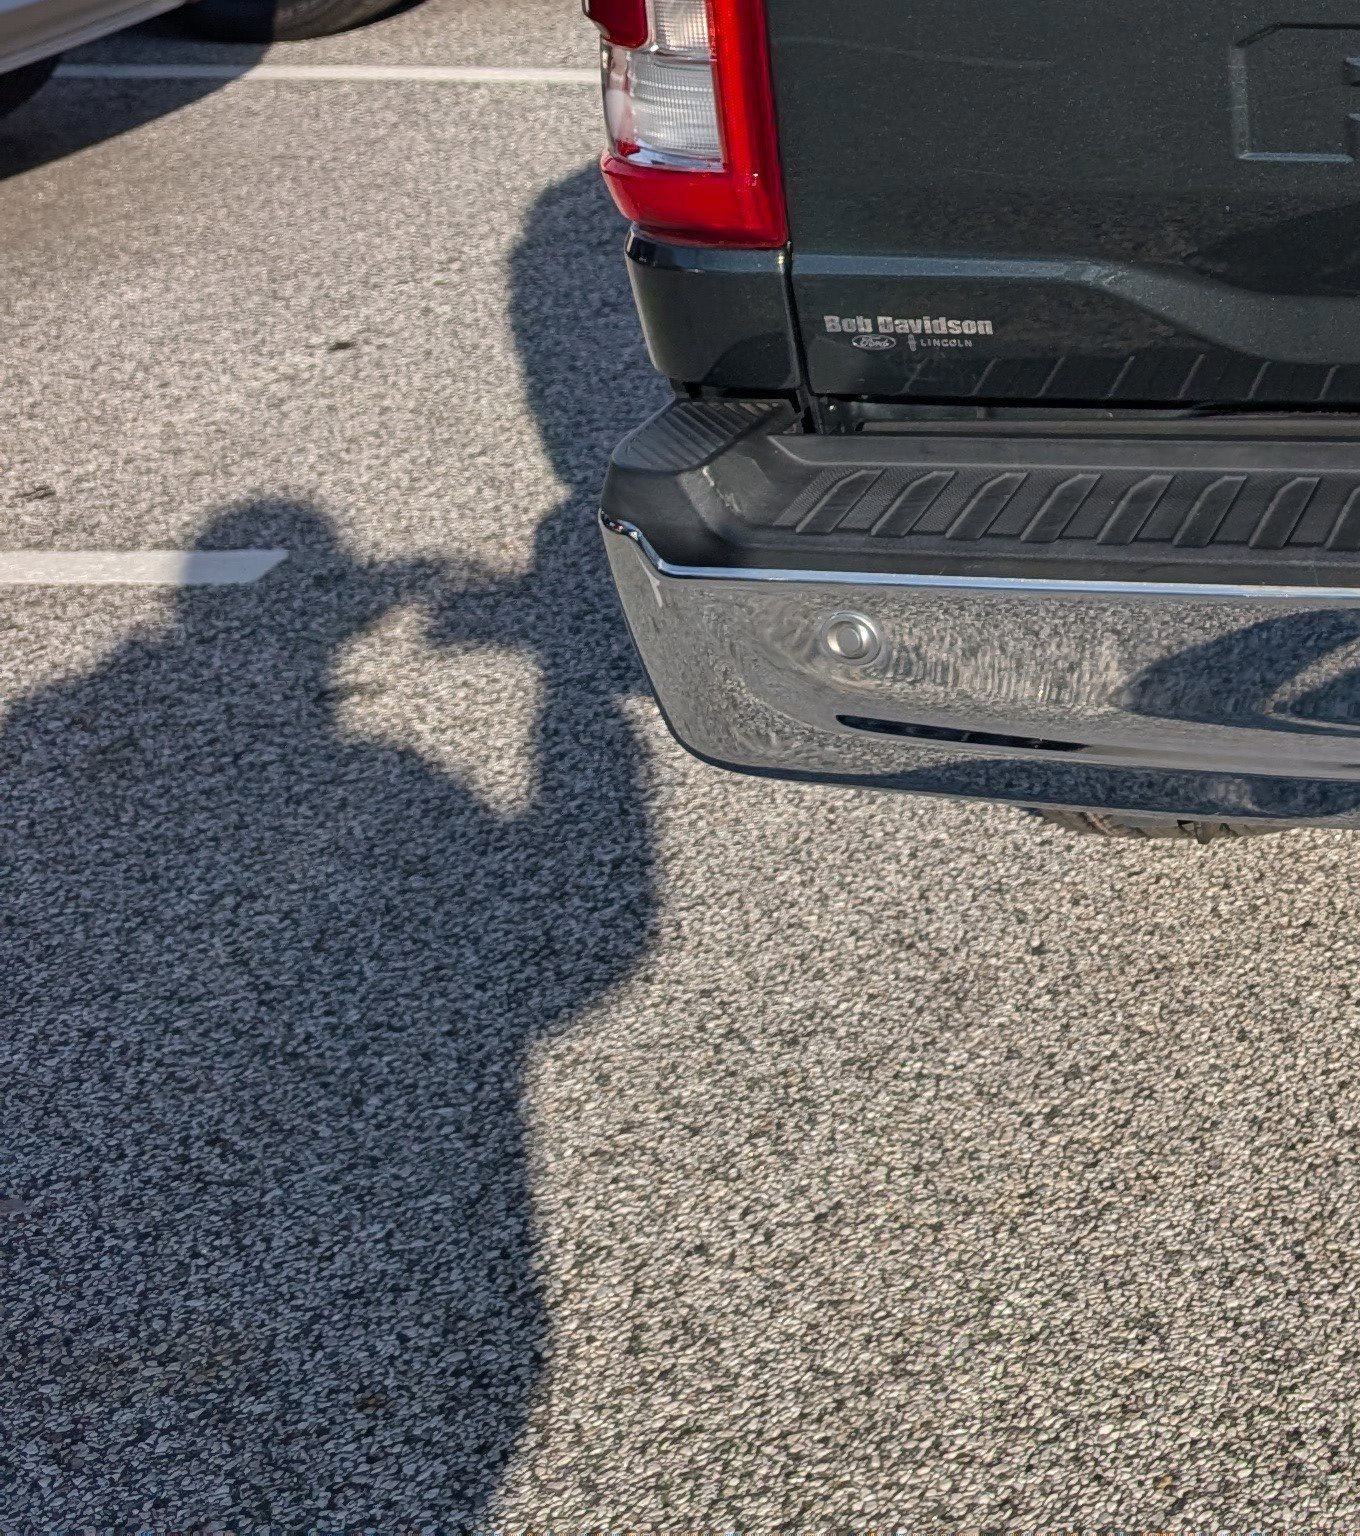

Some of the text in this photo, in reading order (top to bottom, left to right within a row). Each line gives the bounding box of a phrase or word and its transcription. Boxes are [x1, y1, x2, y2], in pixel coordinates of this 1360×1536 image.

[823, 315, 994, 335] Bob Davidson
[920, 338, 973, 348] LINCOLN
